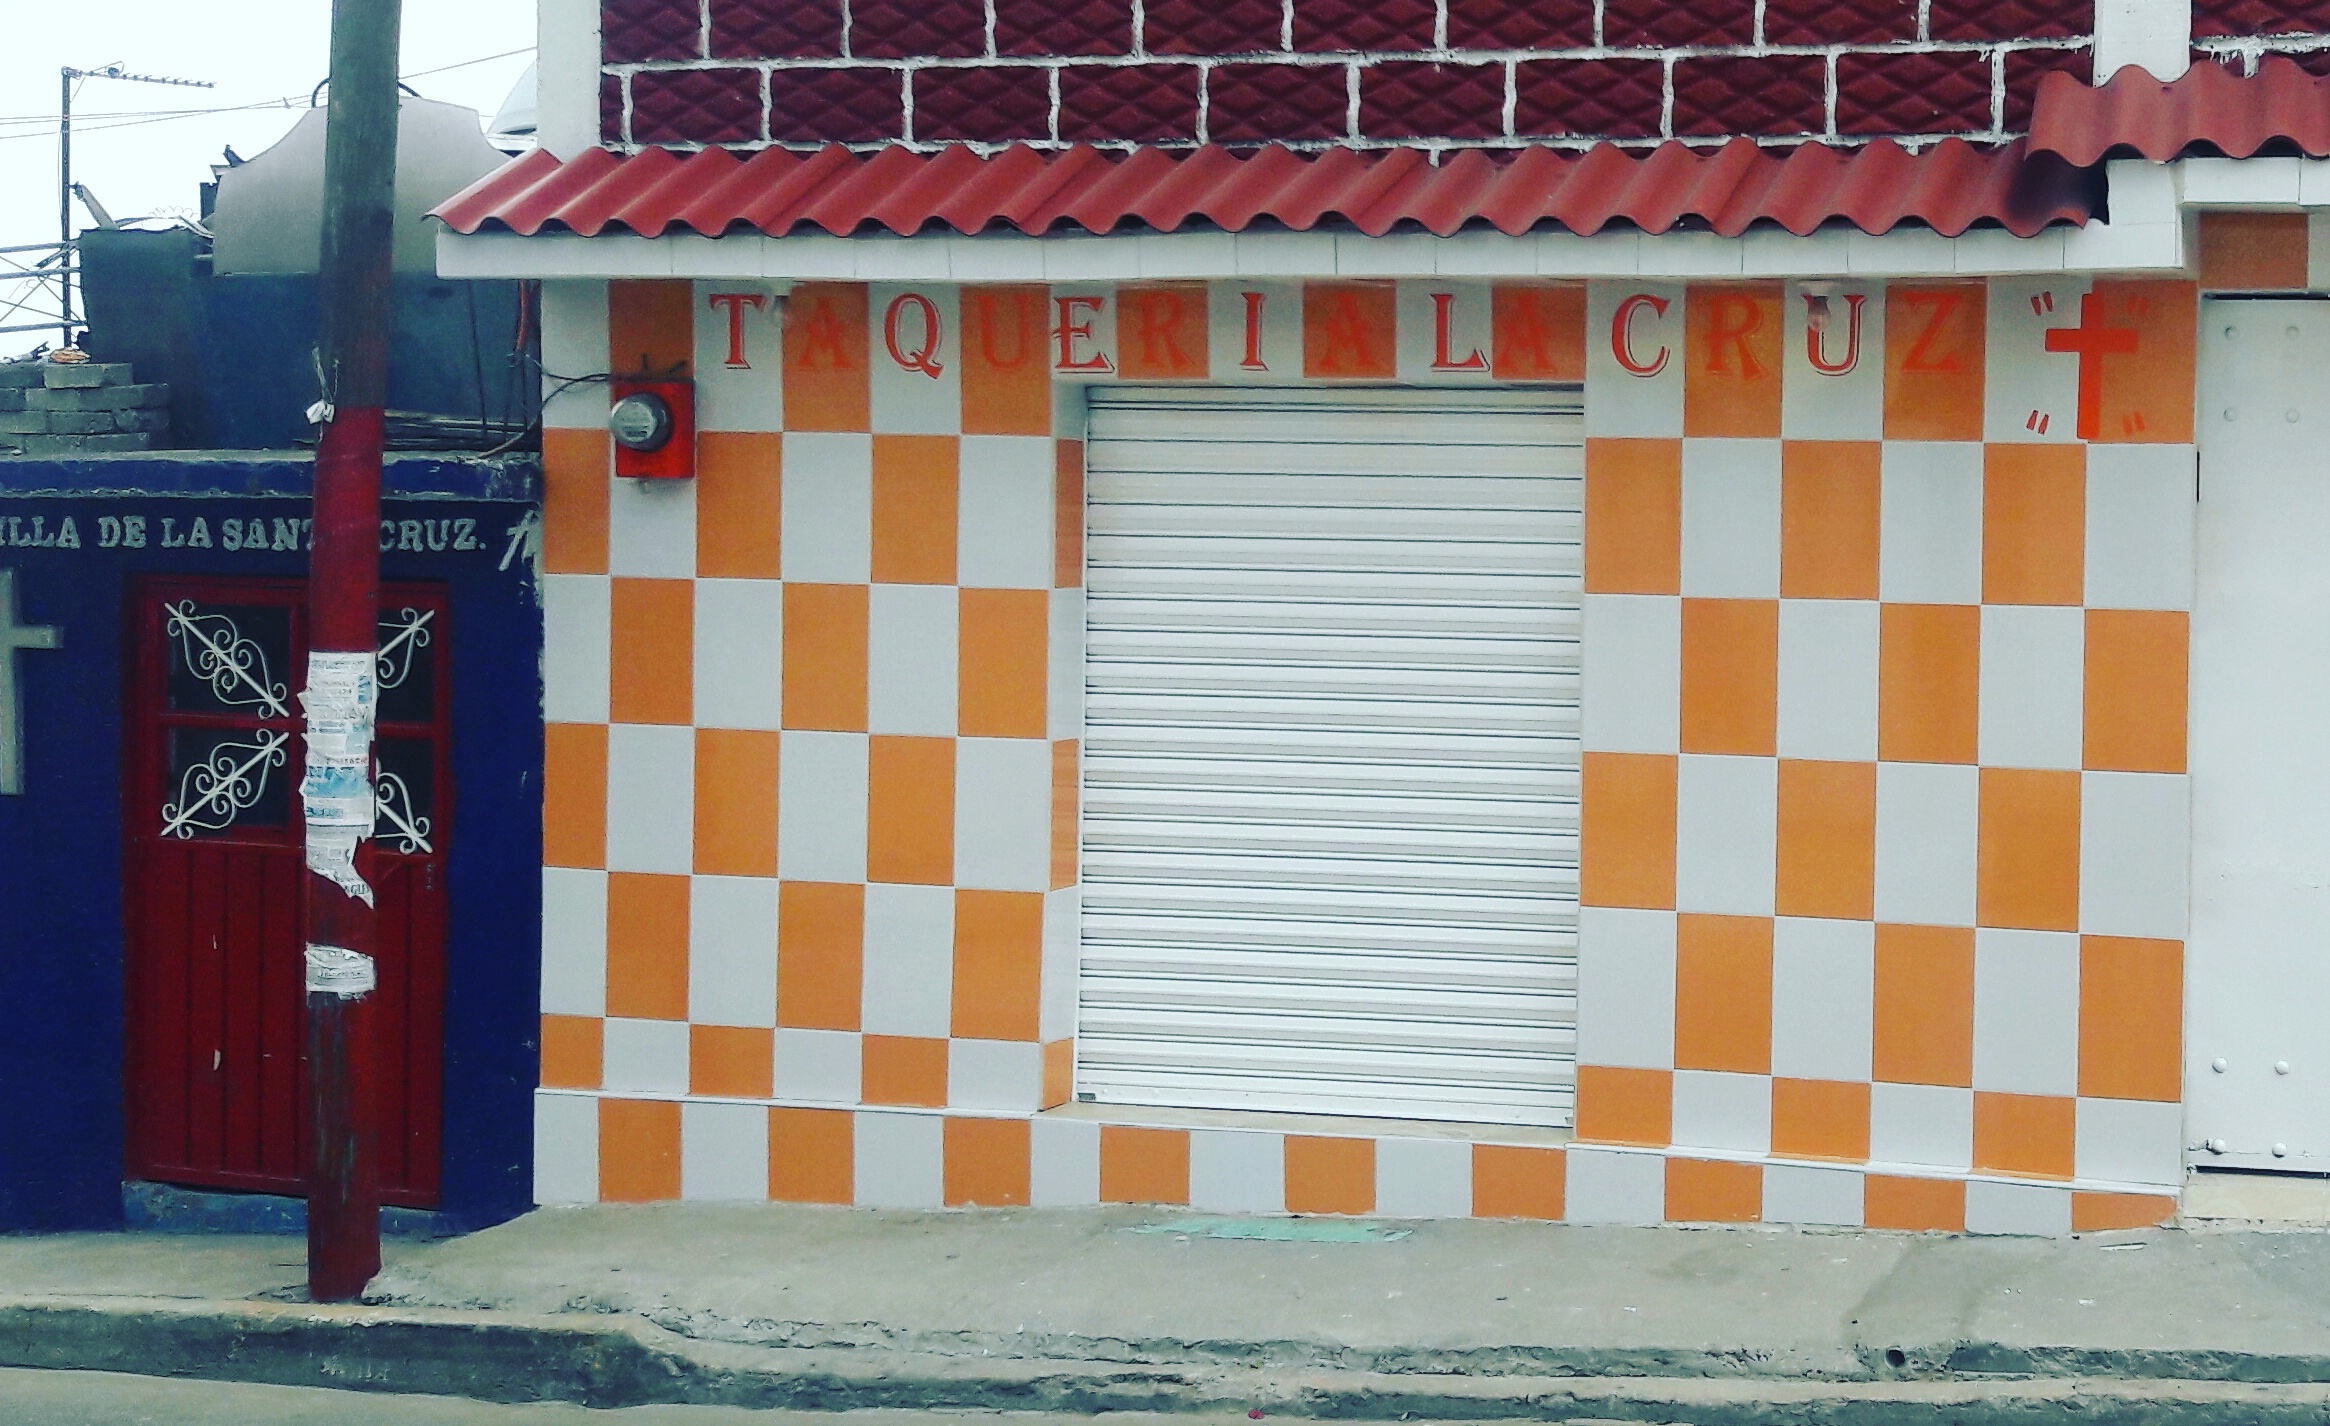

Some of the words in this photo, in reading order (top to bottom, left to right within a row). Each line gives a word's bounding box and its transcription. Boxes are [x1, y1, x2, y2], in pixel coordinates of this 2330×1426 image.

[708, 291, 1380, 380] TAQUERIA
[1430, 292, 1557, 374] LA
[1611, 293, 1962, 380] CRUZ
[97, 515, 147, 549] DE
[160, 516, 214, 549] LA
[221, 517, 315, 551] SAN
